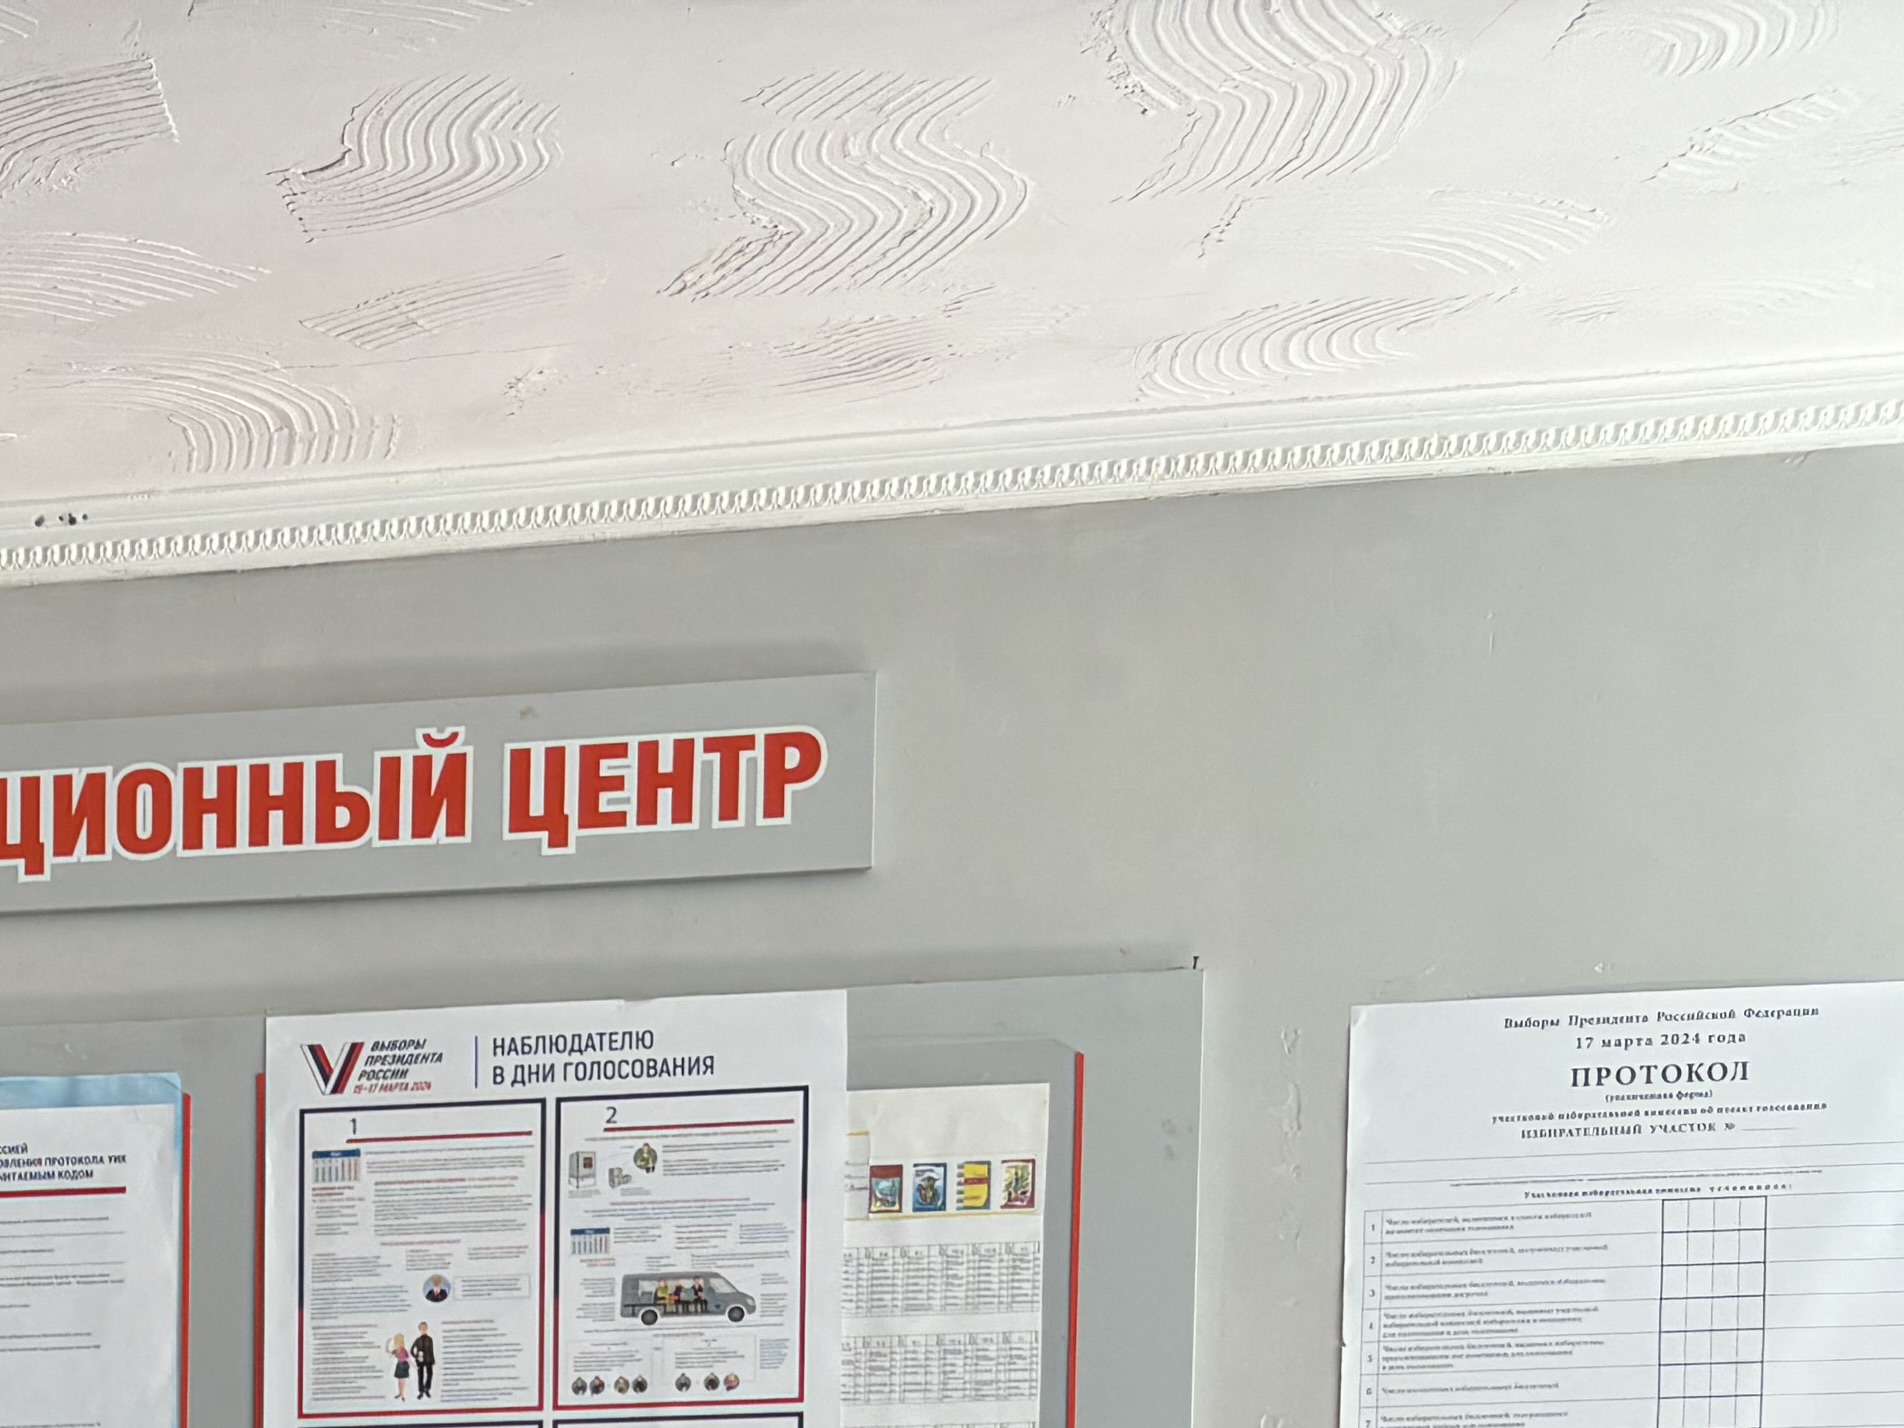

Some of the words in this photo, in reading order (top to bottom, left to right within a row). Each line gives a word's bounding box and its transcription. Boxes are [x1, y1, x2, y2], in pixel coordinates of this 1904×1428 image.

[505, 731, 824, 851] ЦЕНТР
[1504, 1017, 1560, 1031] Выборы
[371, 1038, 427, 1052] ВЫБОРЫ
[492, 1029, 655, 1058] НАБЛЮДАТЕЛЮ
[1575, 1036, 1595, 1049] 17
[1601, 1035, 1654, 1051] марта
[1660, 1032, 1701, 1047] 2024
[1708, 1031, 1746, 1045] года
[364, 1052, 443, 1067] ПРЕЗИДЕНТА
[358, 1068, 409, 1082] РОССИИ
[492, 1066, 504, 1087] В
[511, 1063, 557, 1089] ДНИ
[562, 1056, 715, 1084] ГОЛОСОВАНИЯ
[1570, 1060, 1751, 1088] ПРОТОКОЛ
[605, 1106, 618, 1124] 2
[349, 1118, 357, 1135] 1
[44, 1155, 104, 1167] ПРОТОКОЛА
[58, 1169, 93, 1181] КОДОМ
